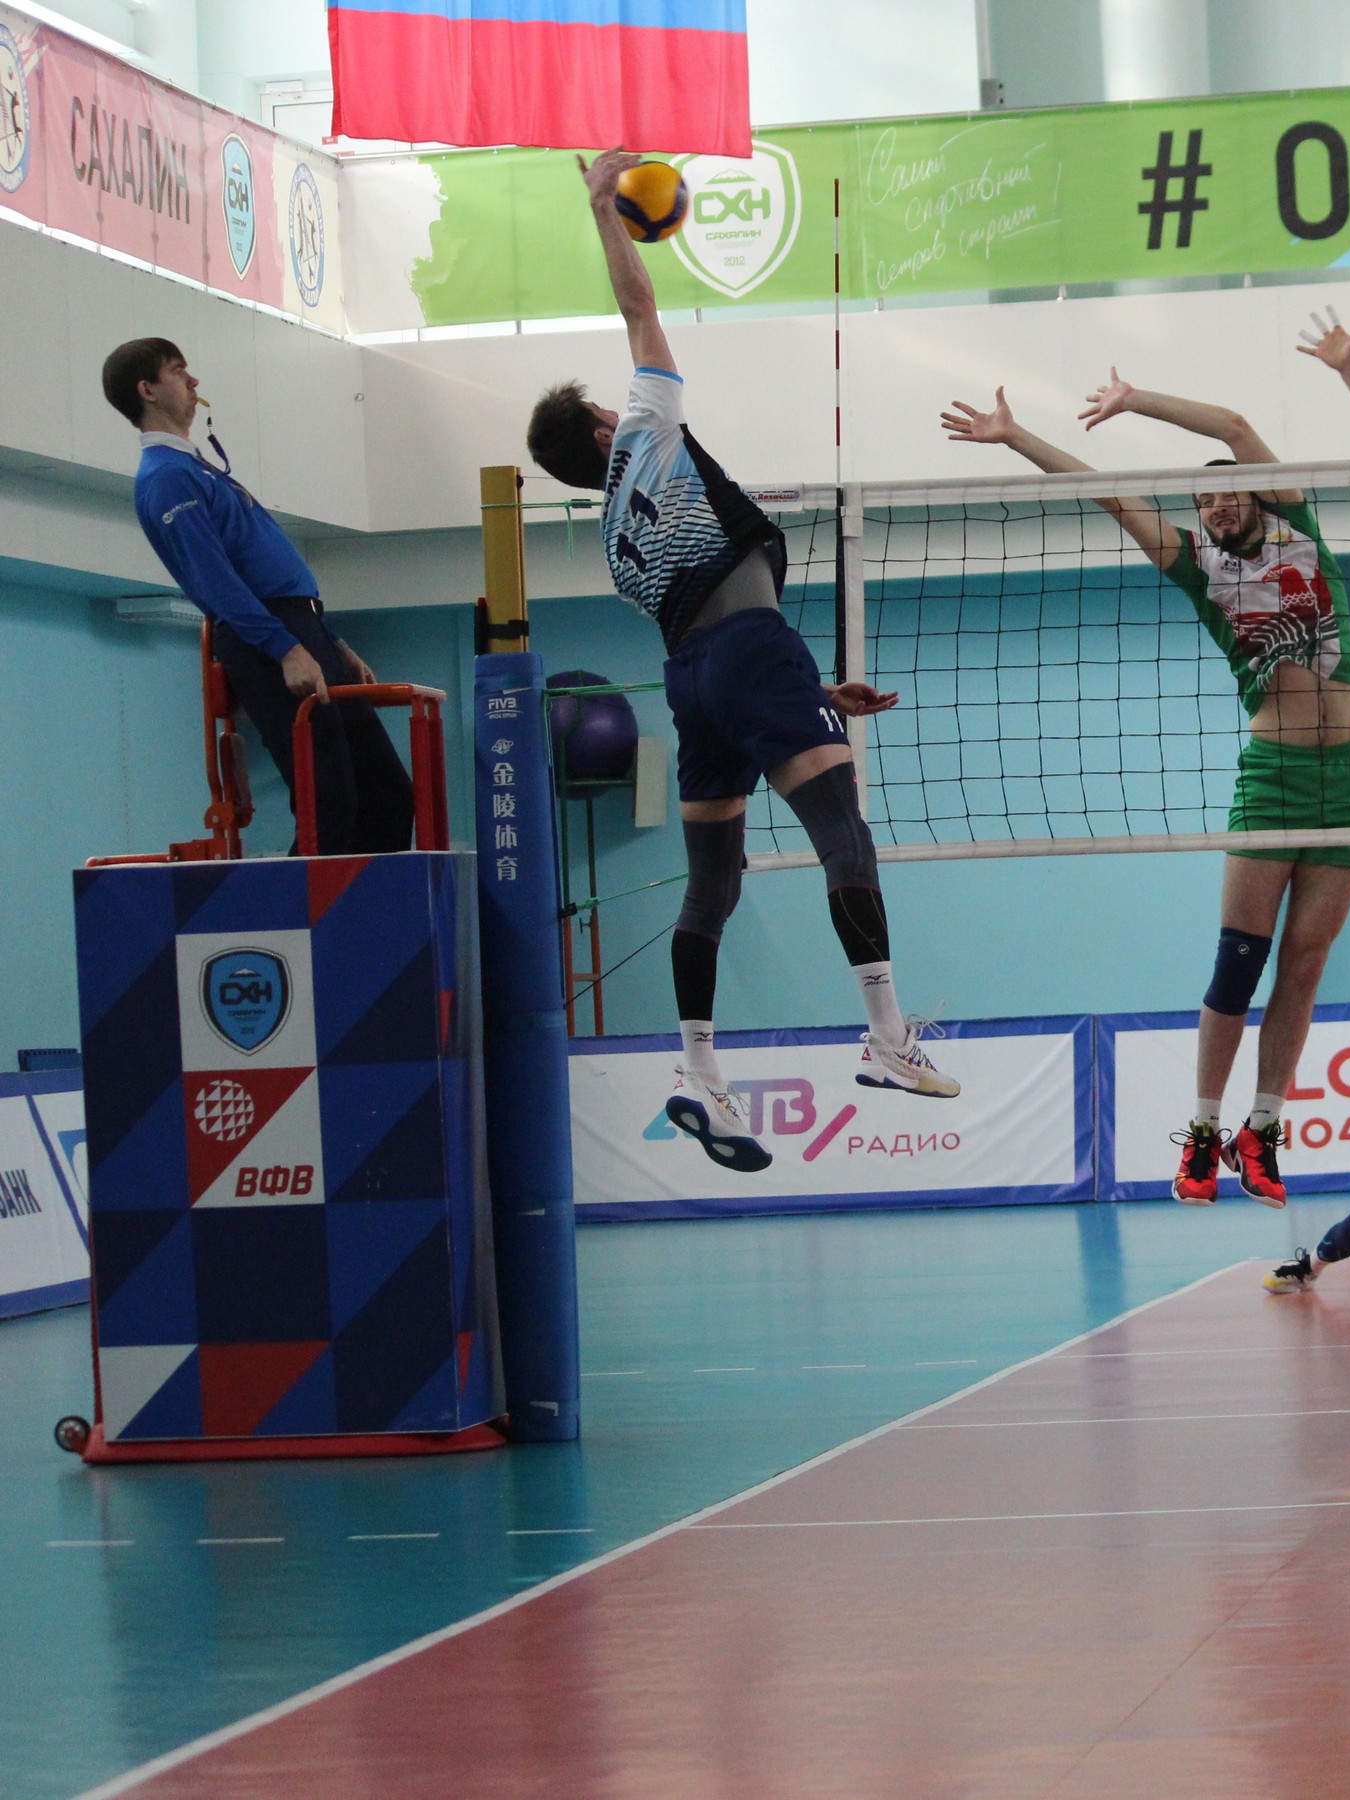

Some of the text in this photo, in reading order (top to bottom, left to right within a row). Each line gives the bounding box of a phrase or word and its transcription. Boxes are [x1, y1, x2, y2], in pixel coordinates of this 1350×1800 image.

[71, 95, 190, 225] САХАЛИН
[705, 229, 762, 241] САХАЛИН
[723, 256, 745, 266] 2012
[488, 697, 517, 710] FIVB
[818, 706, 845, 733] 11
[492, 761, 518, 881] 金陵体育
[848, 1132, 961, 1157] РАДИО
[235, 1165, 315, 1198] ВФВ
